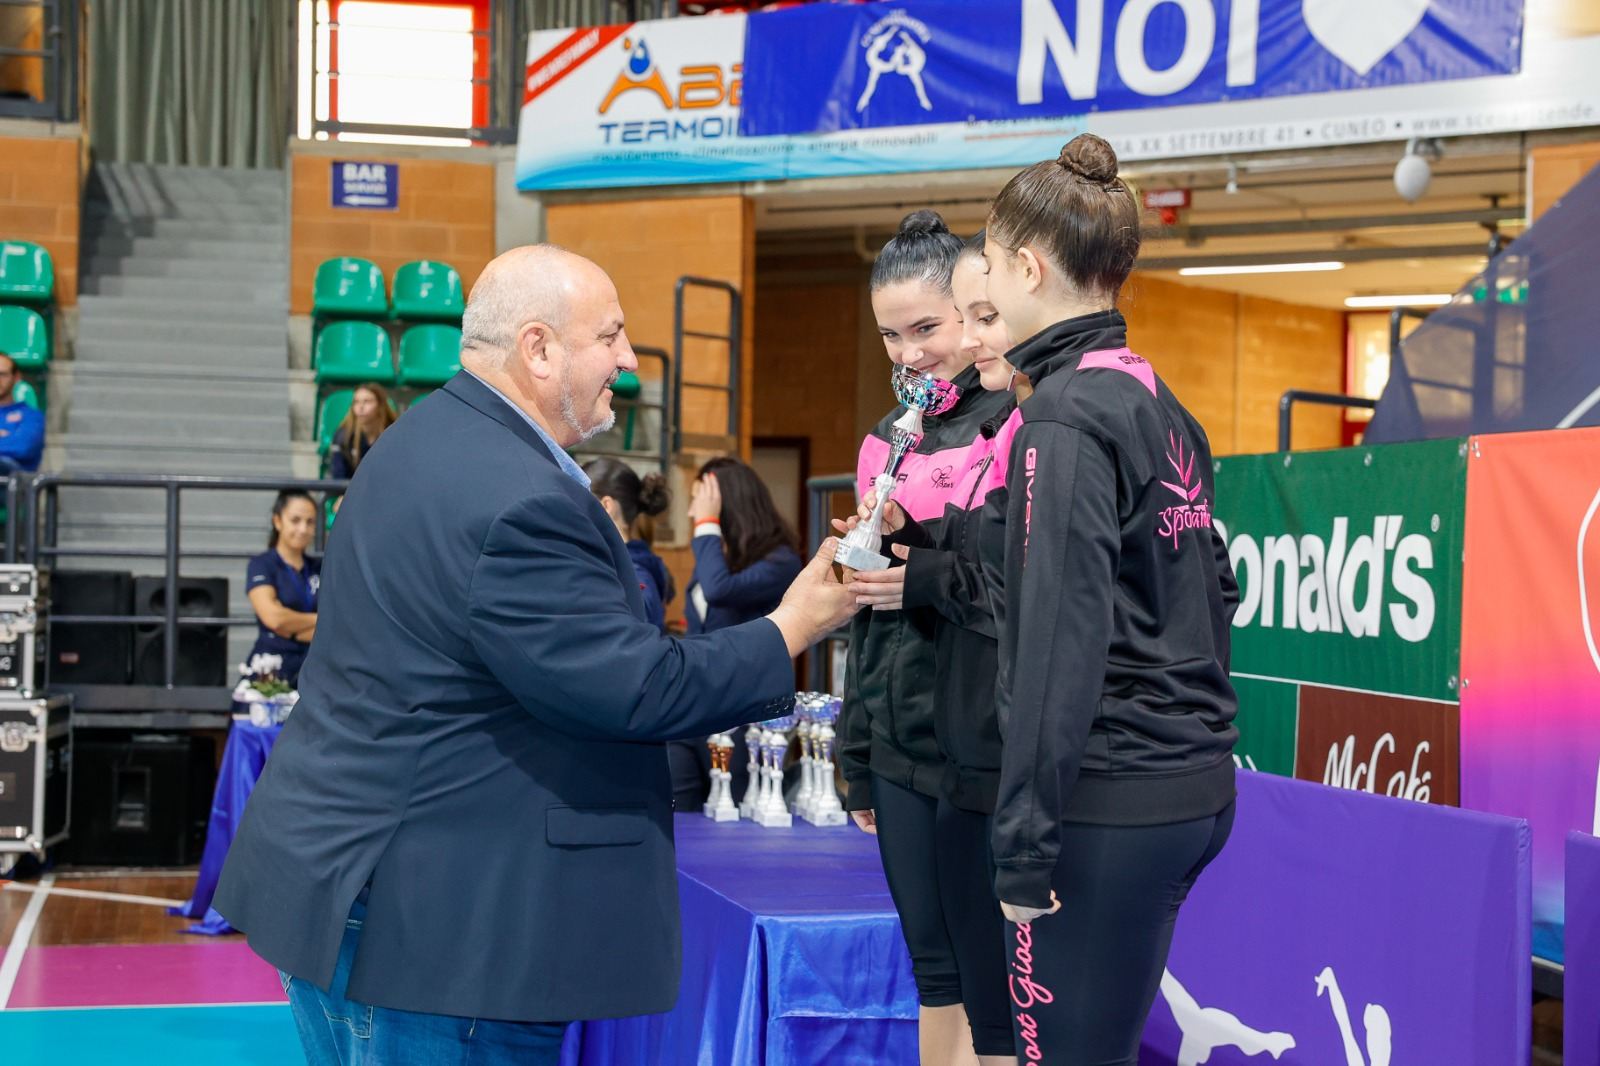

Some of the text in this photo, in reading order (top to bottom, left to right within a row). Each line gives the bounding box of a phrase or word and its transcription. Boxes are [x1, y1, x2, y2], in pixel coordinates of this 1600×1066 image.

[1016, 0, 1260, 105] NOI
[1168, 127, 1266, 151] SETTEMBRE
[1321, 115, 1385, 139] CUNEO
[342, 163, 387, 182] BAR
